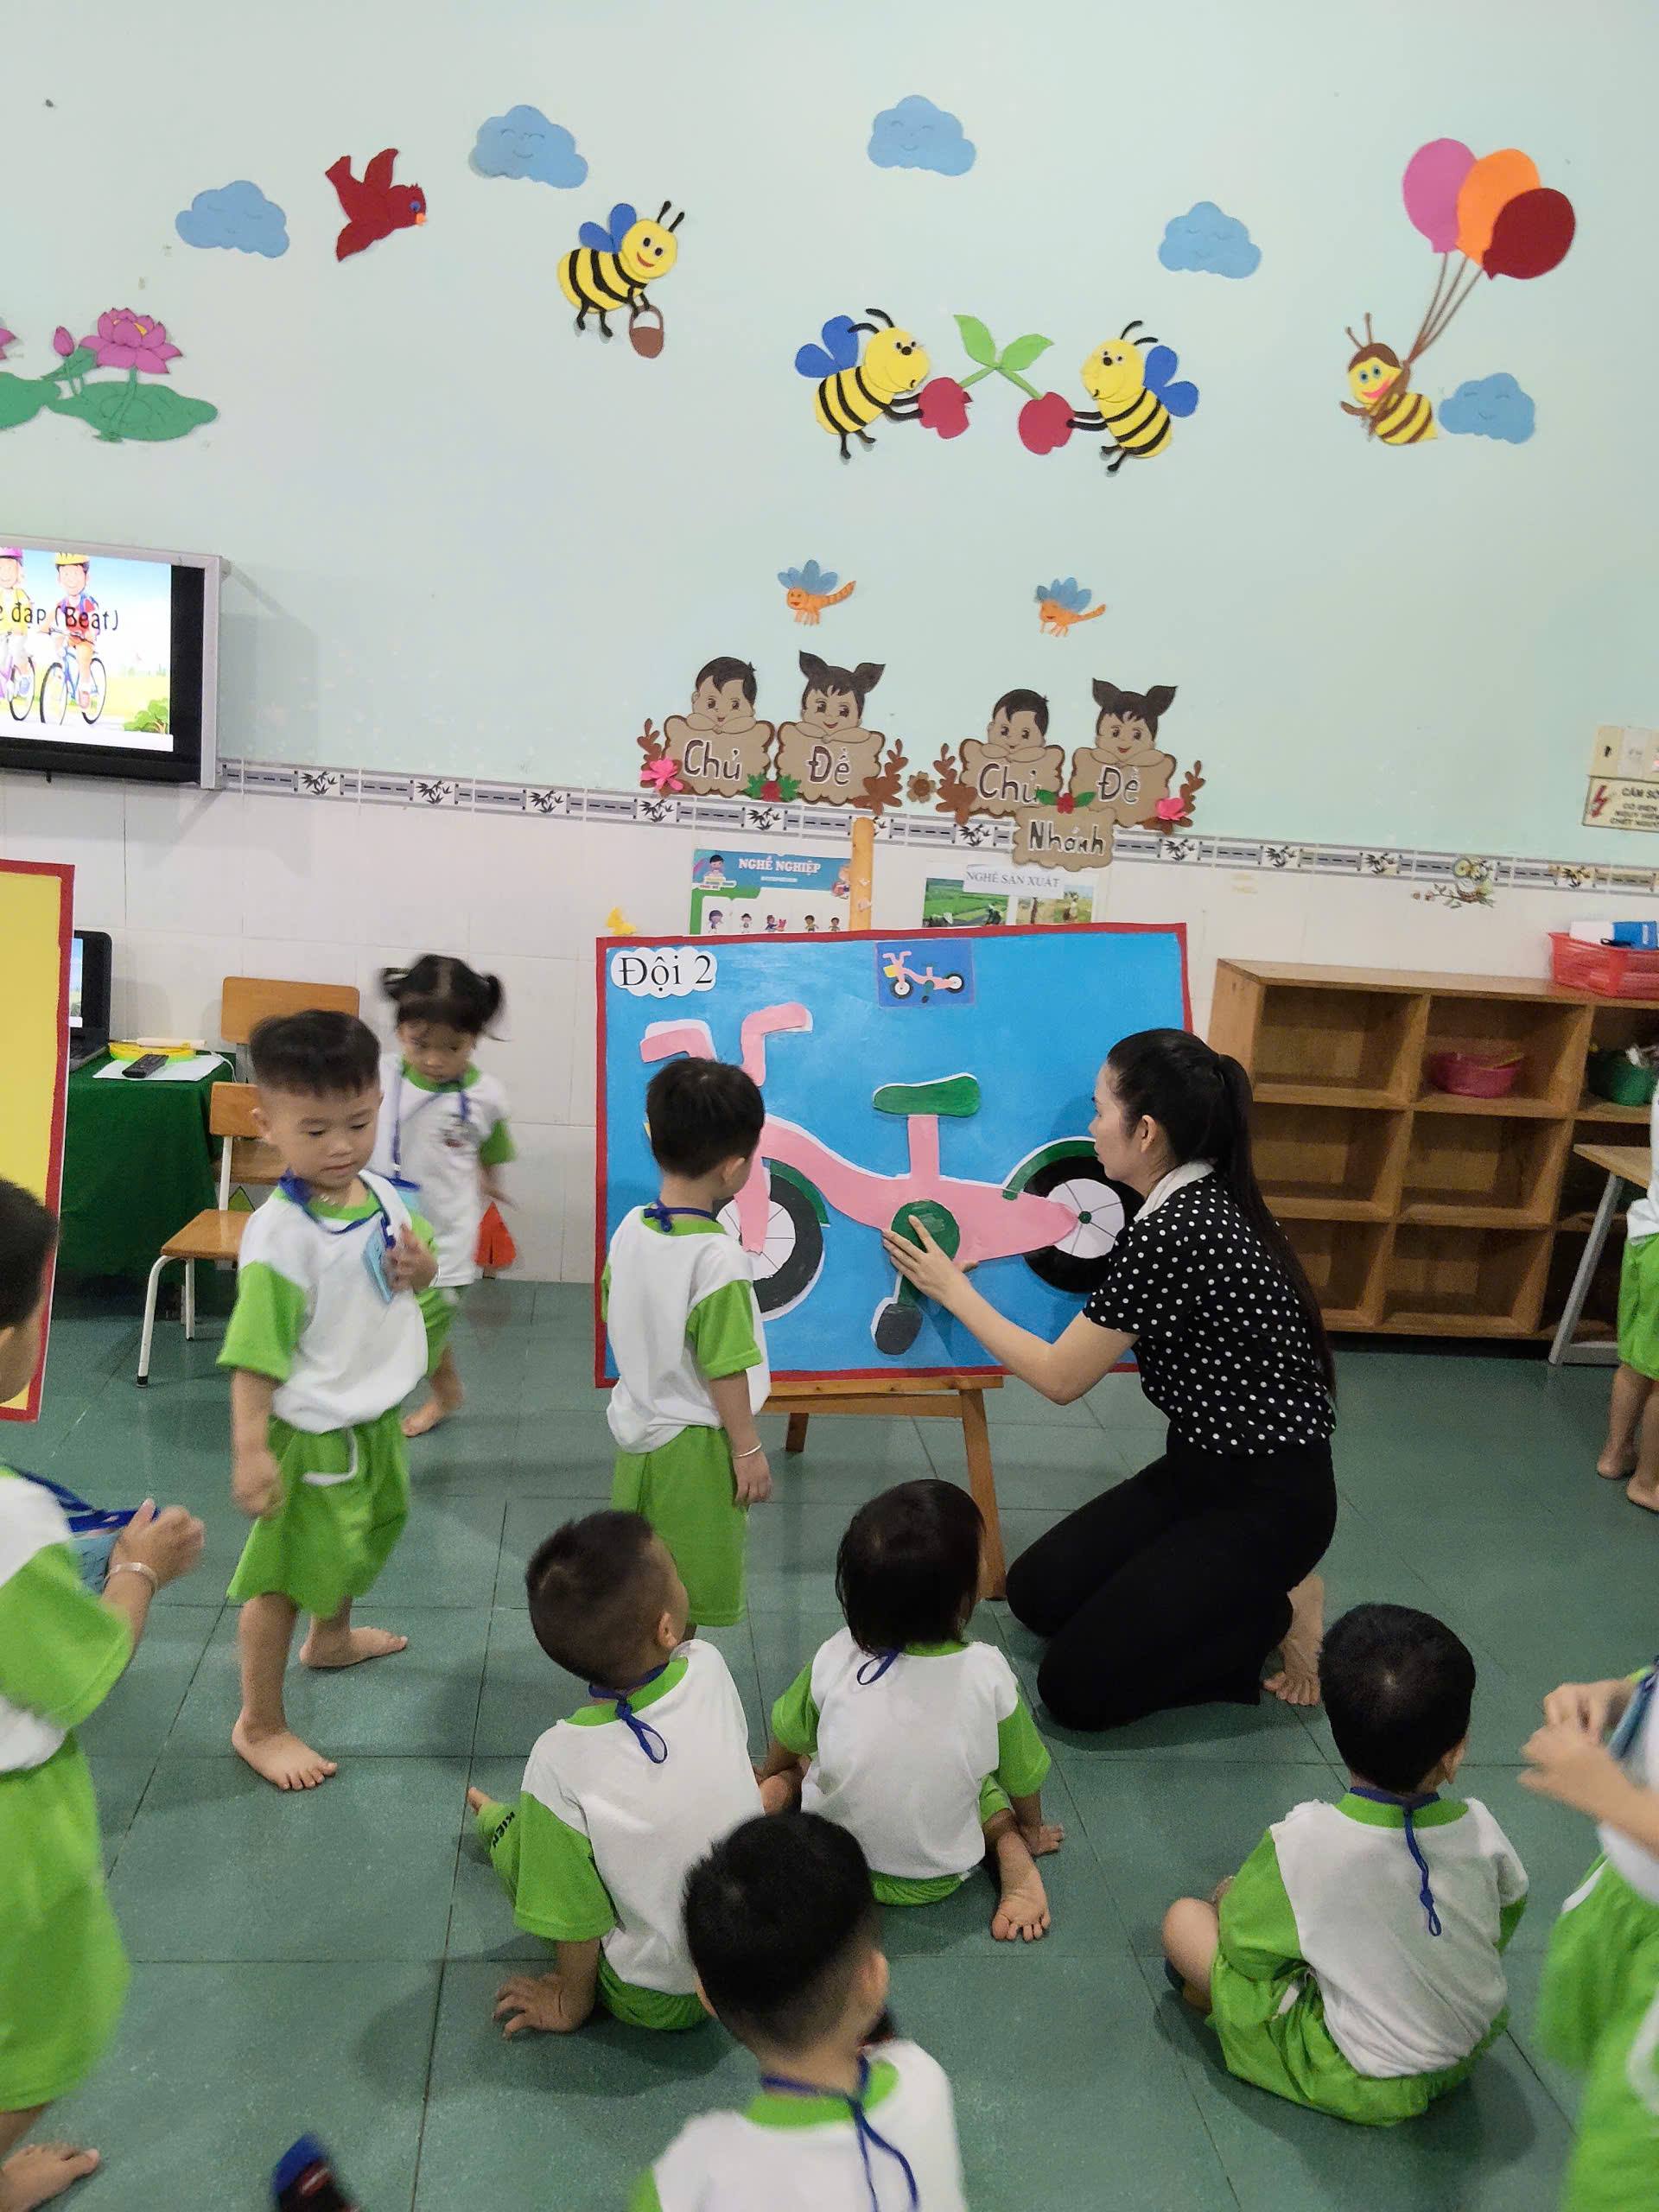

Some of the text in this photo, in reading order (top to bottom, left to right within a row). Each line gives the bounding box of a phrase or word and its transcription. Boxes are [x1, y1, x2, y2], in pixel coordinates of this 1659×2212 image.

[54, 604, 119, 631] (Beat)
[683, 738, 742, 781] Chủ
[619, 954, 714, 991] Đội 2
